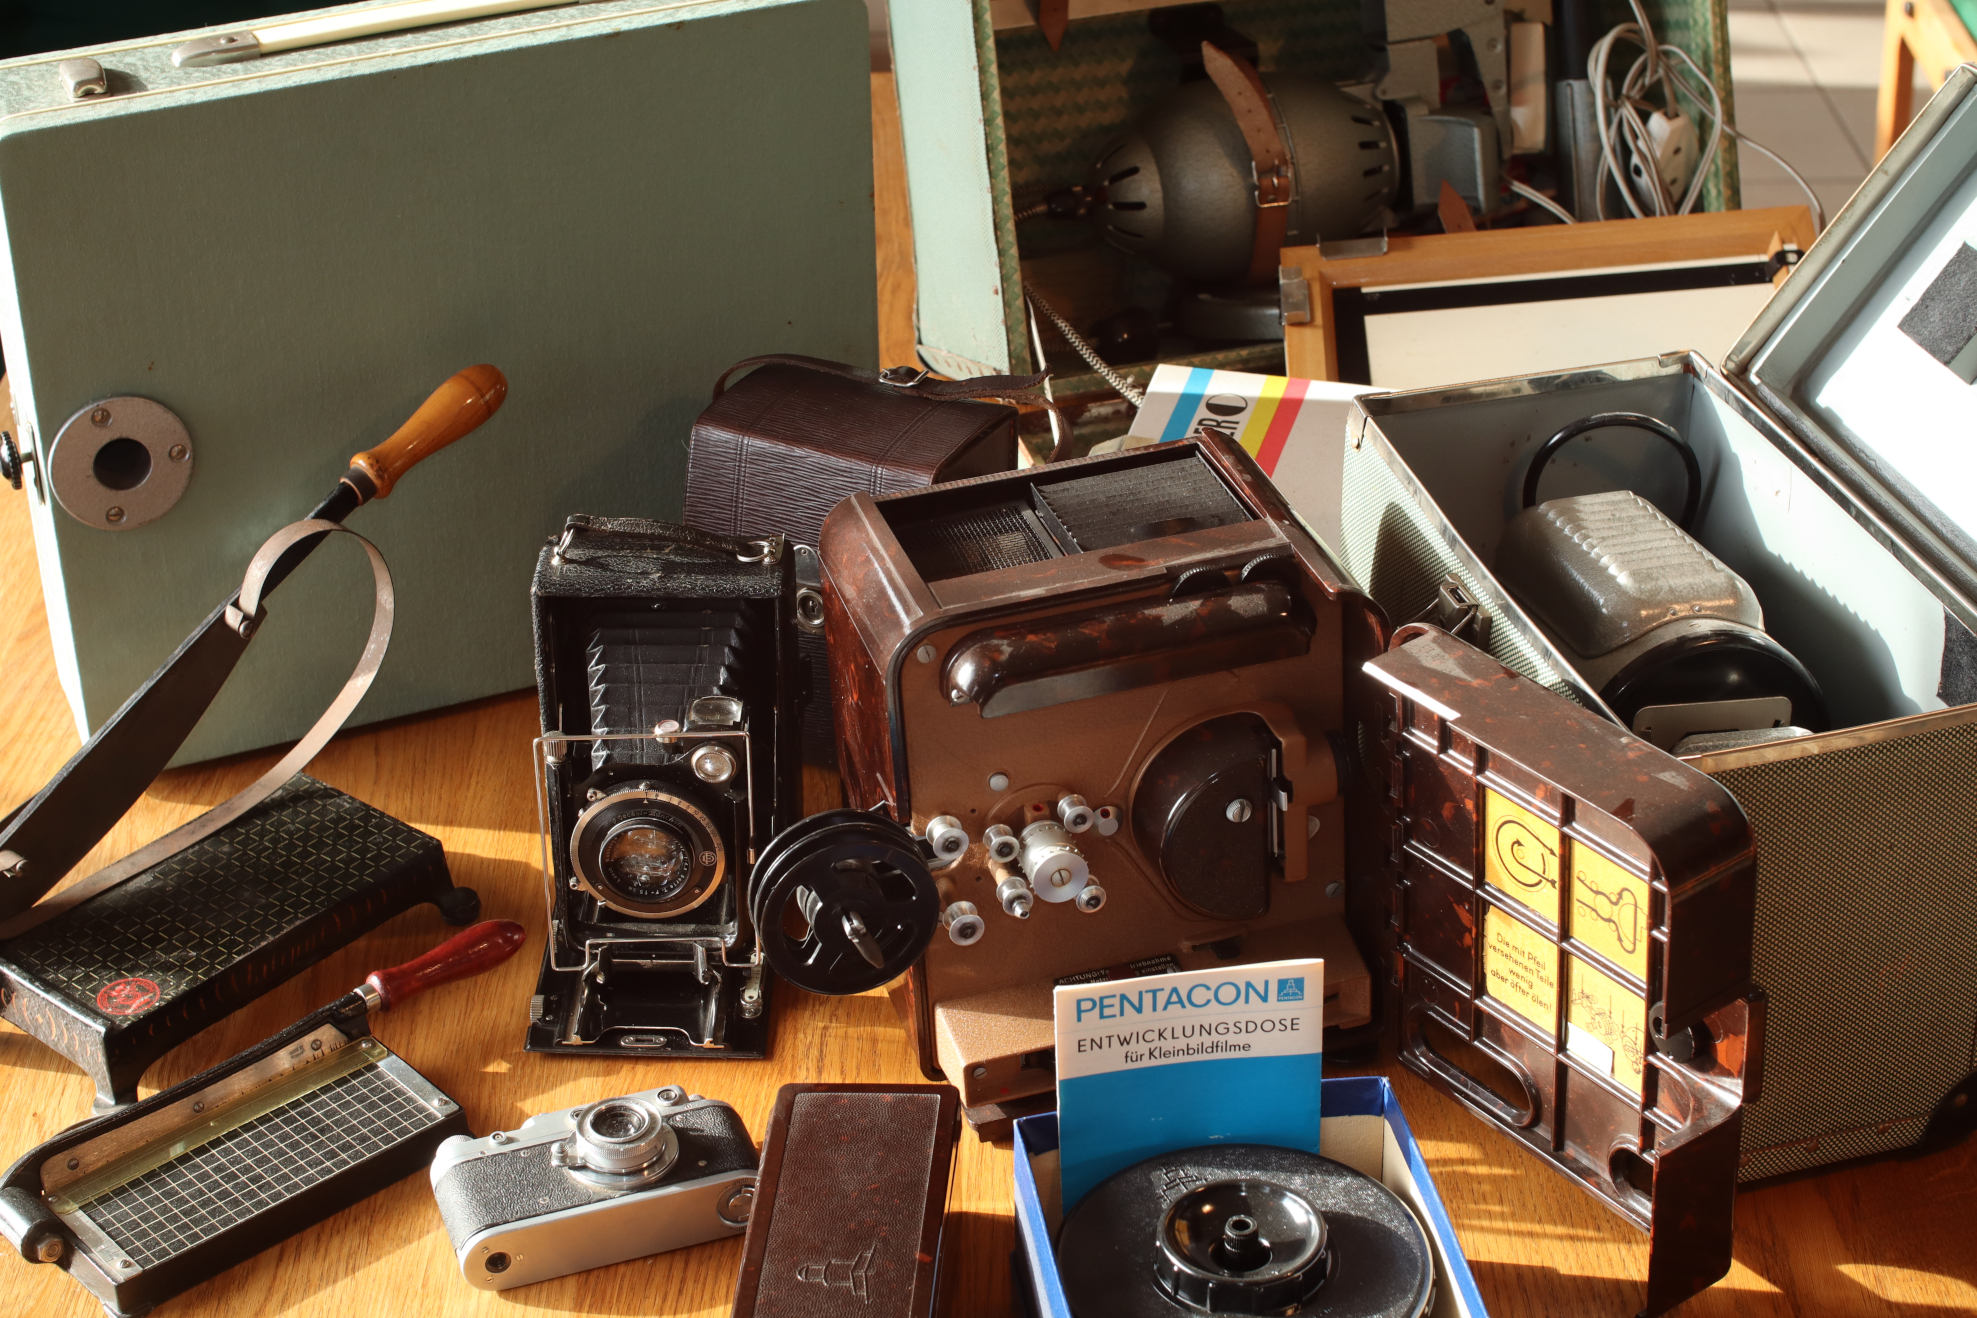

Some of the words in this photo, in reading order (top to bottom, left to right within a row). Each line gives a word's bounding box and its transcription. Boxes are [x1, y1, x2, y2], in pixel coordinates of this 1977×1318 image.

[1129, 955, 1171, 969] triebnahme
[1488, 942, 1534, 976] versehenen
[1535, 968, 1554, 988] Teile
[1496, 933, 1510, 947] Die
[1512, 945, 1525, 957] mit
[1527, 952, 1546, 970] Pfeil
[1490, 969, 1508, 983] aber
[1510, 979, 1530, 997] öfter
[1531, 993, 1552, 1013] ölen!
[1509, 967, 1533, 990] wenig
[1076, 979, 1270, 1023] PENTACON
[1077, 1017, 1301, 1053] ENTWICKLUNGSDOSE
[1124, 1051, 1145, 1064] für
[1147, 1041, 1252, 1061] Kleinbildfilme
